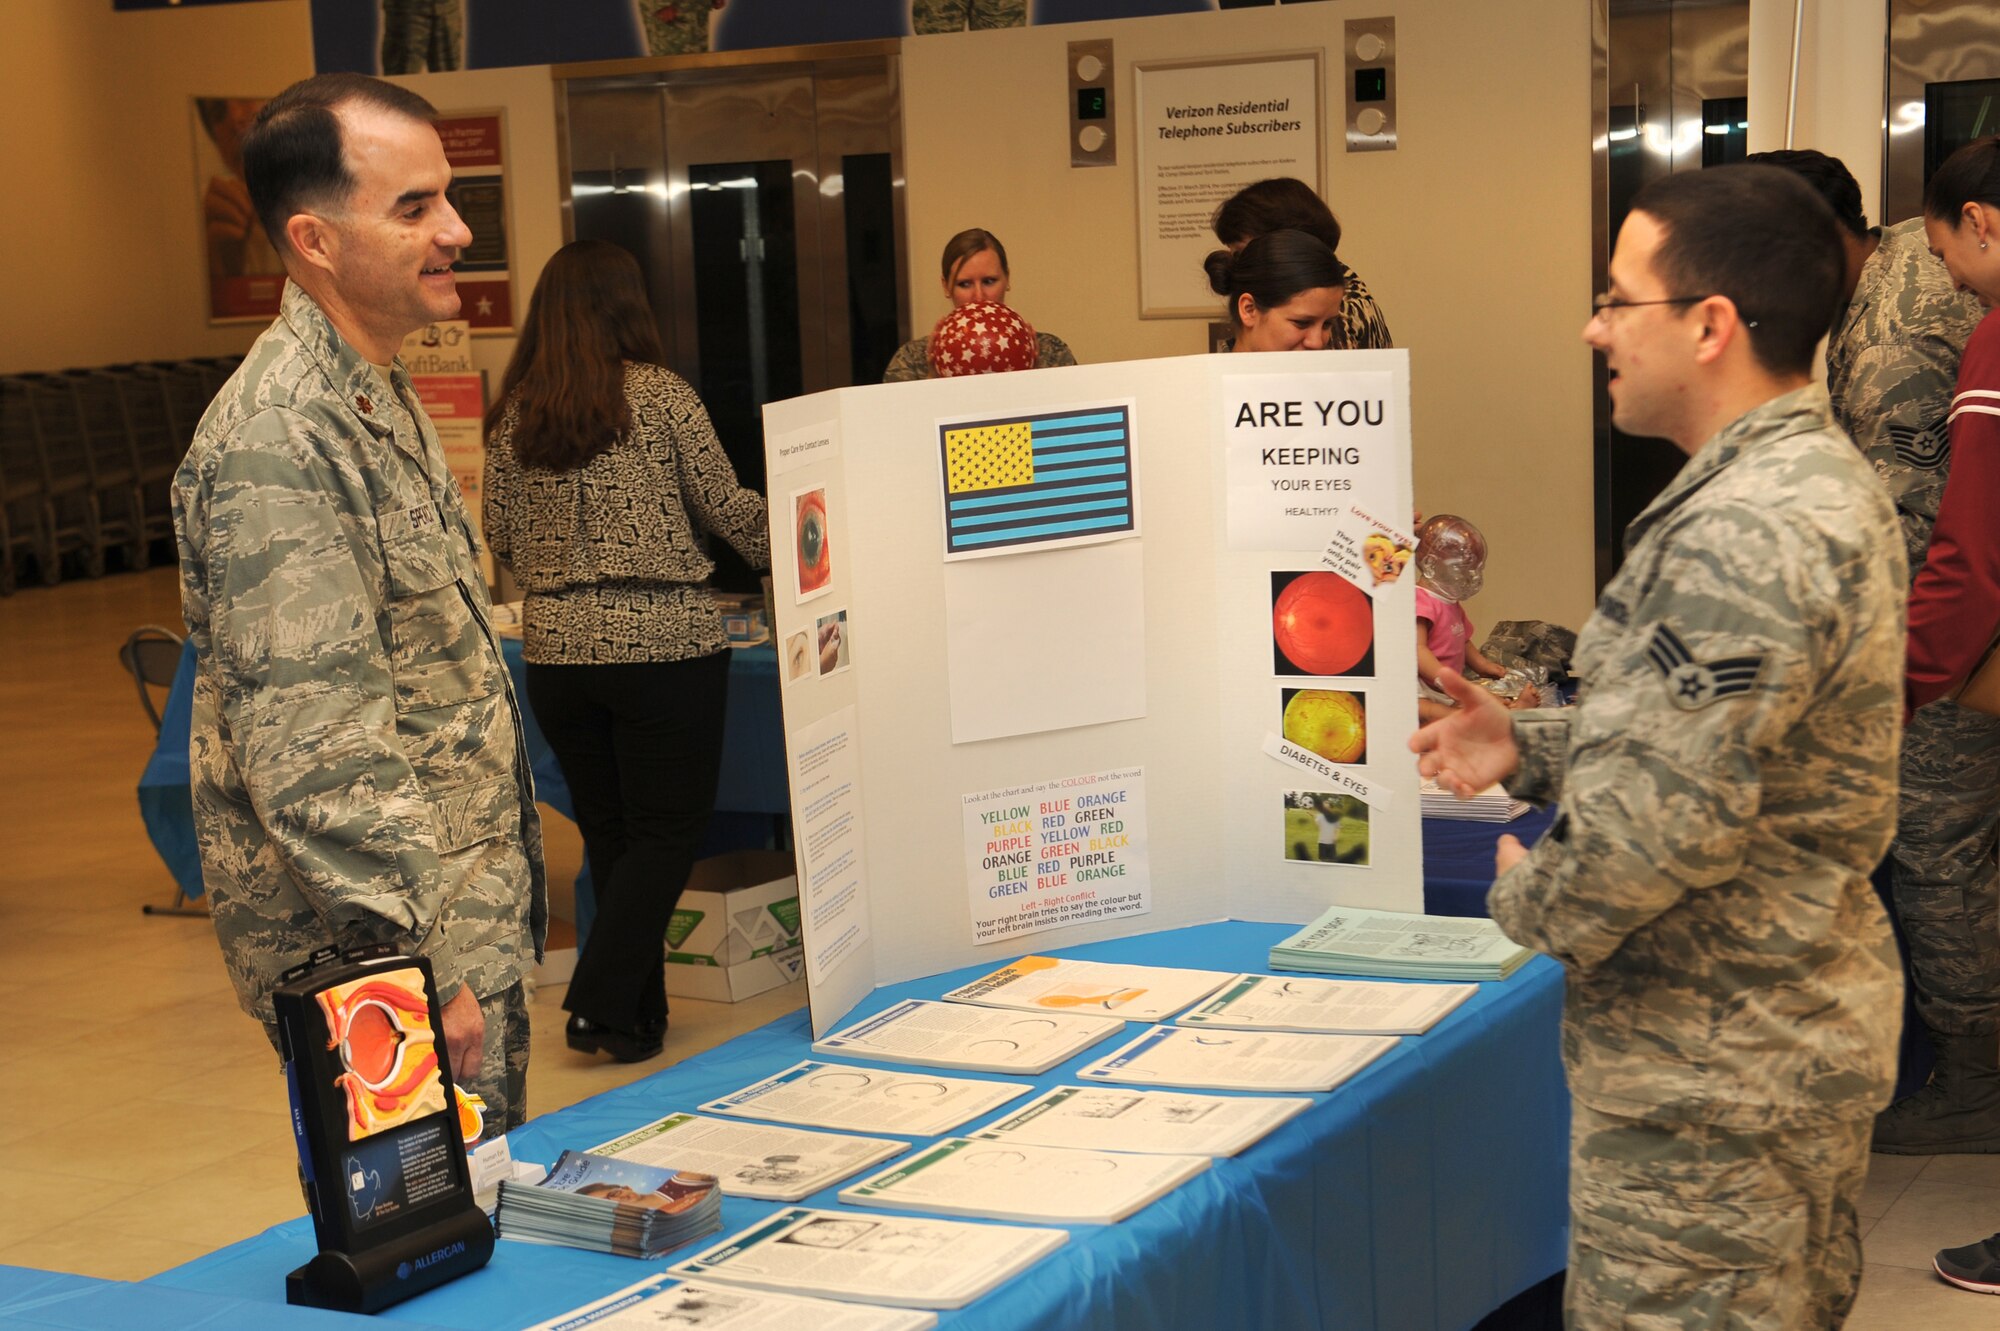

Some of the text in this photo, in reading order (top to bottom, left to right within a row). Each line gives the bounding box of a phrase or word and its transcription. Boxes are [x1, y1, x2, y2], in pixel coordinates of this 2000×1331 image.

[1093, 97, 1102, 110] 2
[1166, 98, 1290, 119] Verizon Residential
[1158, 119, 1301, 141] Telephone Subscribers
[1235, 399, 1383, 428] ARE YOU
[805, 441, 817, 450] Contact
[1262, 447, 1360, 465] KEEPING
[1271, 479, 1352, 491] YOUR EYES
[1284, 507, 1339, 516] HEALTHY?
[1336, 530, 1355, 546] They
[1351, 506, 1414, 548] Love your eyes
[1327, 548, 1362, 571] only pair
[1331, 540, 1359, 559] are the
[1321, 556, 1357, 579] you have
[1280, 745, 1369, 796] DIABETES & EYES
[964, 769, 1142, 804] Look at the chart and say the COLOUR not the word
[981, 790, 1127, 824] YELLOW BLUE ORANGE
[994, 807, 1114, 838] BLACK RED GREEN
[986, 820, 1124, 854] PURPLE YELLOW RED
[982, 834, 1129, 870] ORANGE GREEN BLACK
[998, 851, 1115, 882] BLUE RED PURPLE
[989, 864, 1126, 899] GREEN BLUE ORANGE
[976, 892, 1142, 929] Your right brain tries to say the colour but
[1021, 902, 1036, 912] Left
[1044, 896, 1064, 907] Right
[1065, 891, 1096, 903] Conflict
[976, 902, 1143, 939] your left brain insists on reading the word.
[558, 1173, 571, 1186] Eye
[568, 1160, 591, 1186] Guide
[415, 1240, 465, 1272] ALLERGAN
